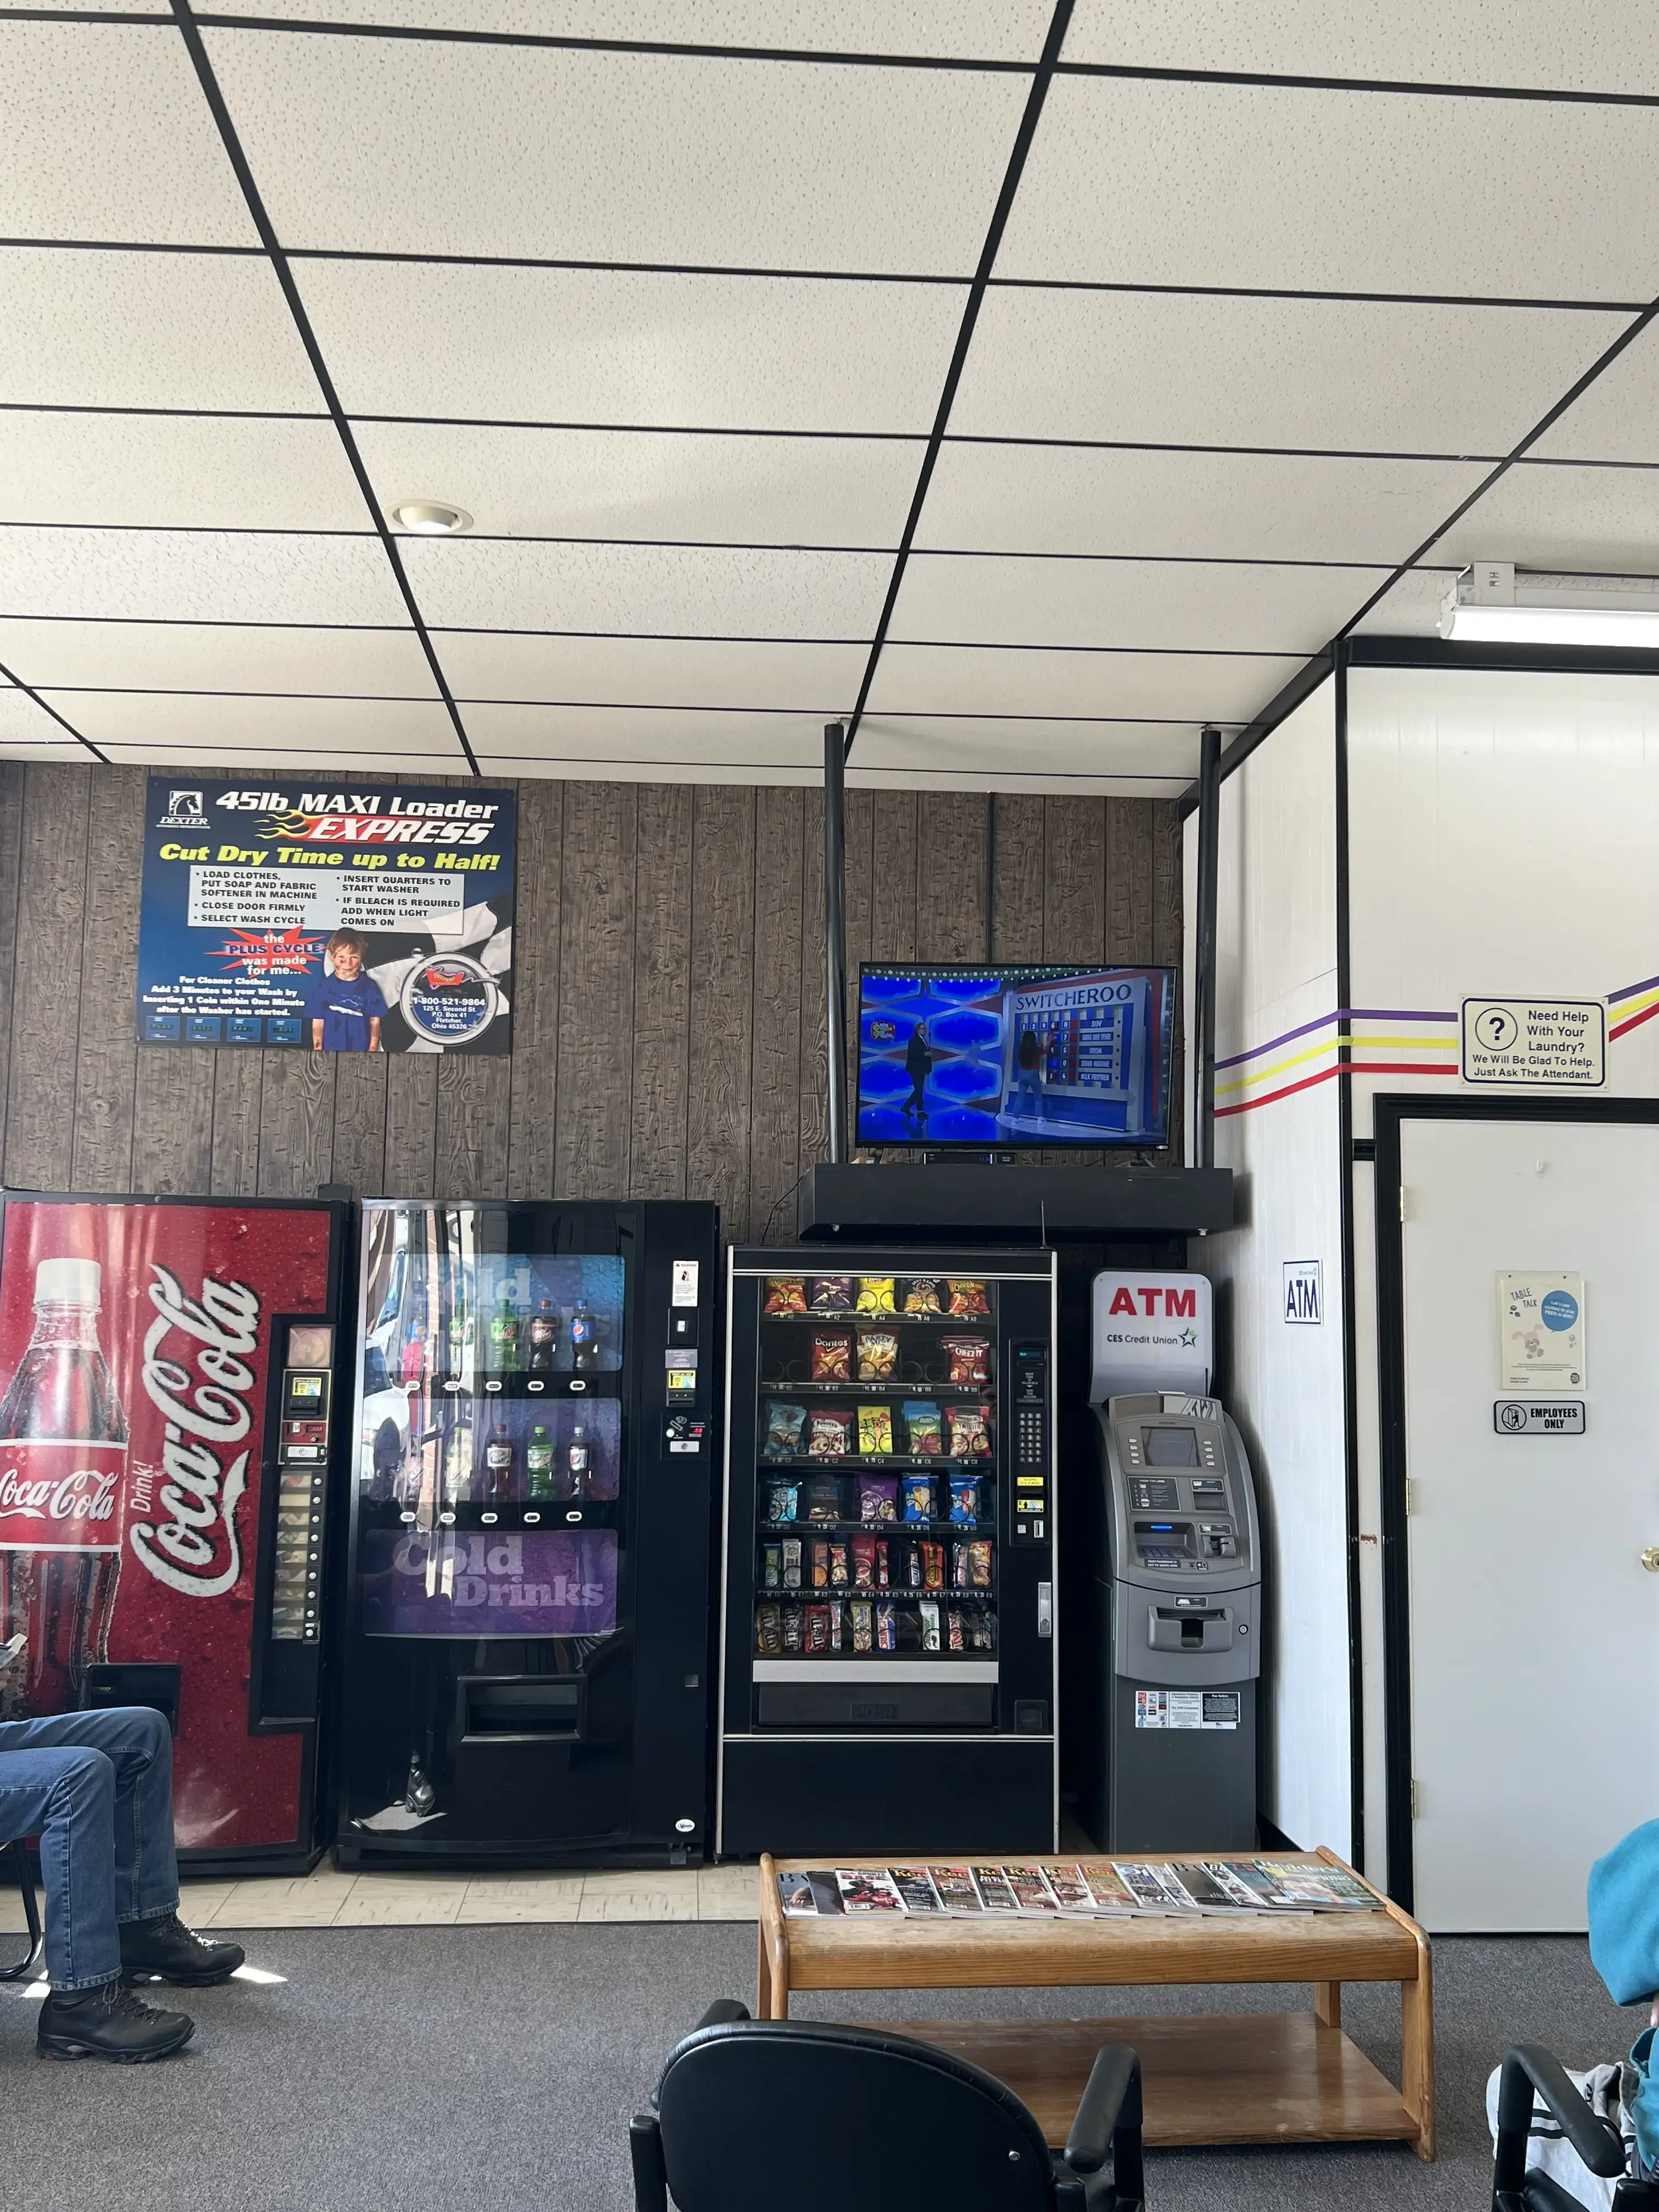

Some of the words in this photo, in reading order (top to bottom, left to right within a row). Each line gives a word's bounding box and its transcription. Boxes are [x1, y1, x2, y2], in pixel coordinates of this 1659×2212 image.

[216, 791, 289, 810] 45lb
[298, 793, 381, 814] MAXI
[389, 797, 499, 819] Loader
[159, 816, 208, 825] DEXTER
[308, 817, 495, 844] EXPRESS
[160, 844, 210, 861] Cut
[217, 845, 269, 866] Dry
[276, 847, 343, 865] Time
[352, 853, 387, 870] up
[397, 853, 426, 867] to
[434, 853, 501, 870] Half!
[234, 872, 281, 881] CLOTHES,
[383, 877, 435, 885] QUARTERS
[377, 885, 420, 894] WASHER
[356, 897, 394, 905] BLEACH
[411, 899, 460, 907] REQUIRED
[201, 914, 238, 922] SELECT
[263, 934, 285, 944] the
[229, 945, 267, 954] PLUS
[273, 944, 320, 953] CYCLE
[242, 956, 268, 966] was
[272, 955, 307, 965] made
[247, 965, 266, 975] for
[270, 967, 302, 975] me...
[197, 977, 233, 985] Cleaner
[235, 978, 270, 986] Clothes
[151, 985, 171, 994] Add
[182, 986, 220, 995] Minutes
[285, 989, 297, 997] by
[143, 995, 185, 1005] Inserting
[196, 996, 218, 1005] Coin
[272, 998, 305, 1007] Minute
[413, 997, 486, 1006] 1-800-521-9864
[1015, 984, 1132, 1010] SWITCHEROO
[156, 1006, 179, 1014] after
[199, 1007, 234, 1015] Washer
[254, 1008, 291, 1016] started.
[1528, 1010, 1558, 1020] Need
[1562, 1012, 1589, 1024] Help
[1489, 1017, 1505, 1041] ?
[1527, 1025, 1554, 1036] With
[1558, 1026, 1585, 1037] Your
[1528, 1041, 1584, 1054] Laundry?
[1472, 1054, 1488, 1063] We
[1491, 1055, 1509, 1064] Will
[1513, 1056, 1525, 1064] Be
[1528, 1056, 1551, 1065] Glad
[1554, 1057, 1567, 1065] To
[1570, 1058, 1595, 1068] Help.
[1474, 1068, 1496, 1076] Just
[1499, 1068, 1518, 1077] Ask
[1521, 1069, 1539, 1077] The
[1542, 1070, 1593, 1079] Attendant.
[1286, 1279, 1318, 1318] ATM
[1510, 1288, 1532, 1301] TABLE
[1109, 1287, 1196, 1317] ATM
[1523, 1299, 1537, 1308] TALK
[815, 1338, 848, 1347] Doritos
[865, 1335, 892, 1344] PARTY
[1107, 1334, 1122, 1343] CES
[1125, 1335, 1150, 1344] Credit
[1153, 1336, 1178, 1345] Union
[955, 1347, 983, 1357] CHEEZ-IT
[1531, 1408, 1577, 1418] EMPLOYEES
[129, 1262, 262, 1597] Coca-Cola
[1544, 1419, 1565, 1429] ONLY
[130, 1460, 154, 1513] Drink!
[393, 1531, 524, 1576] Cold
[454, 1575, 604, 1607] Drinks
